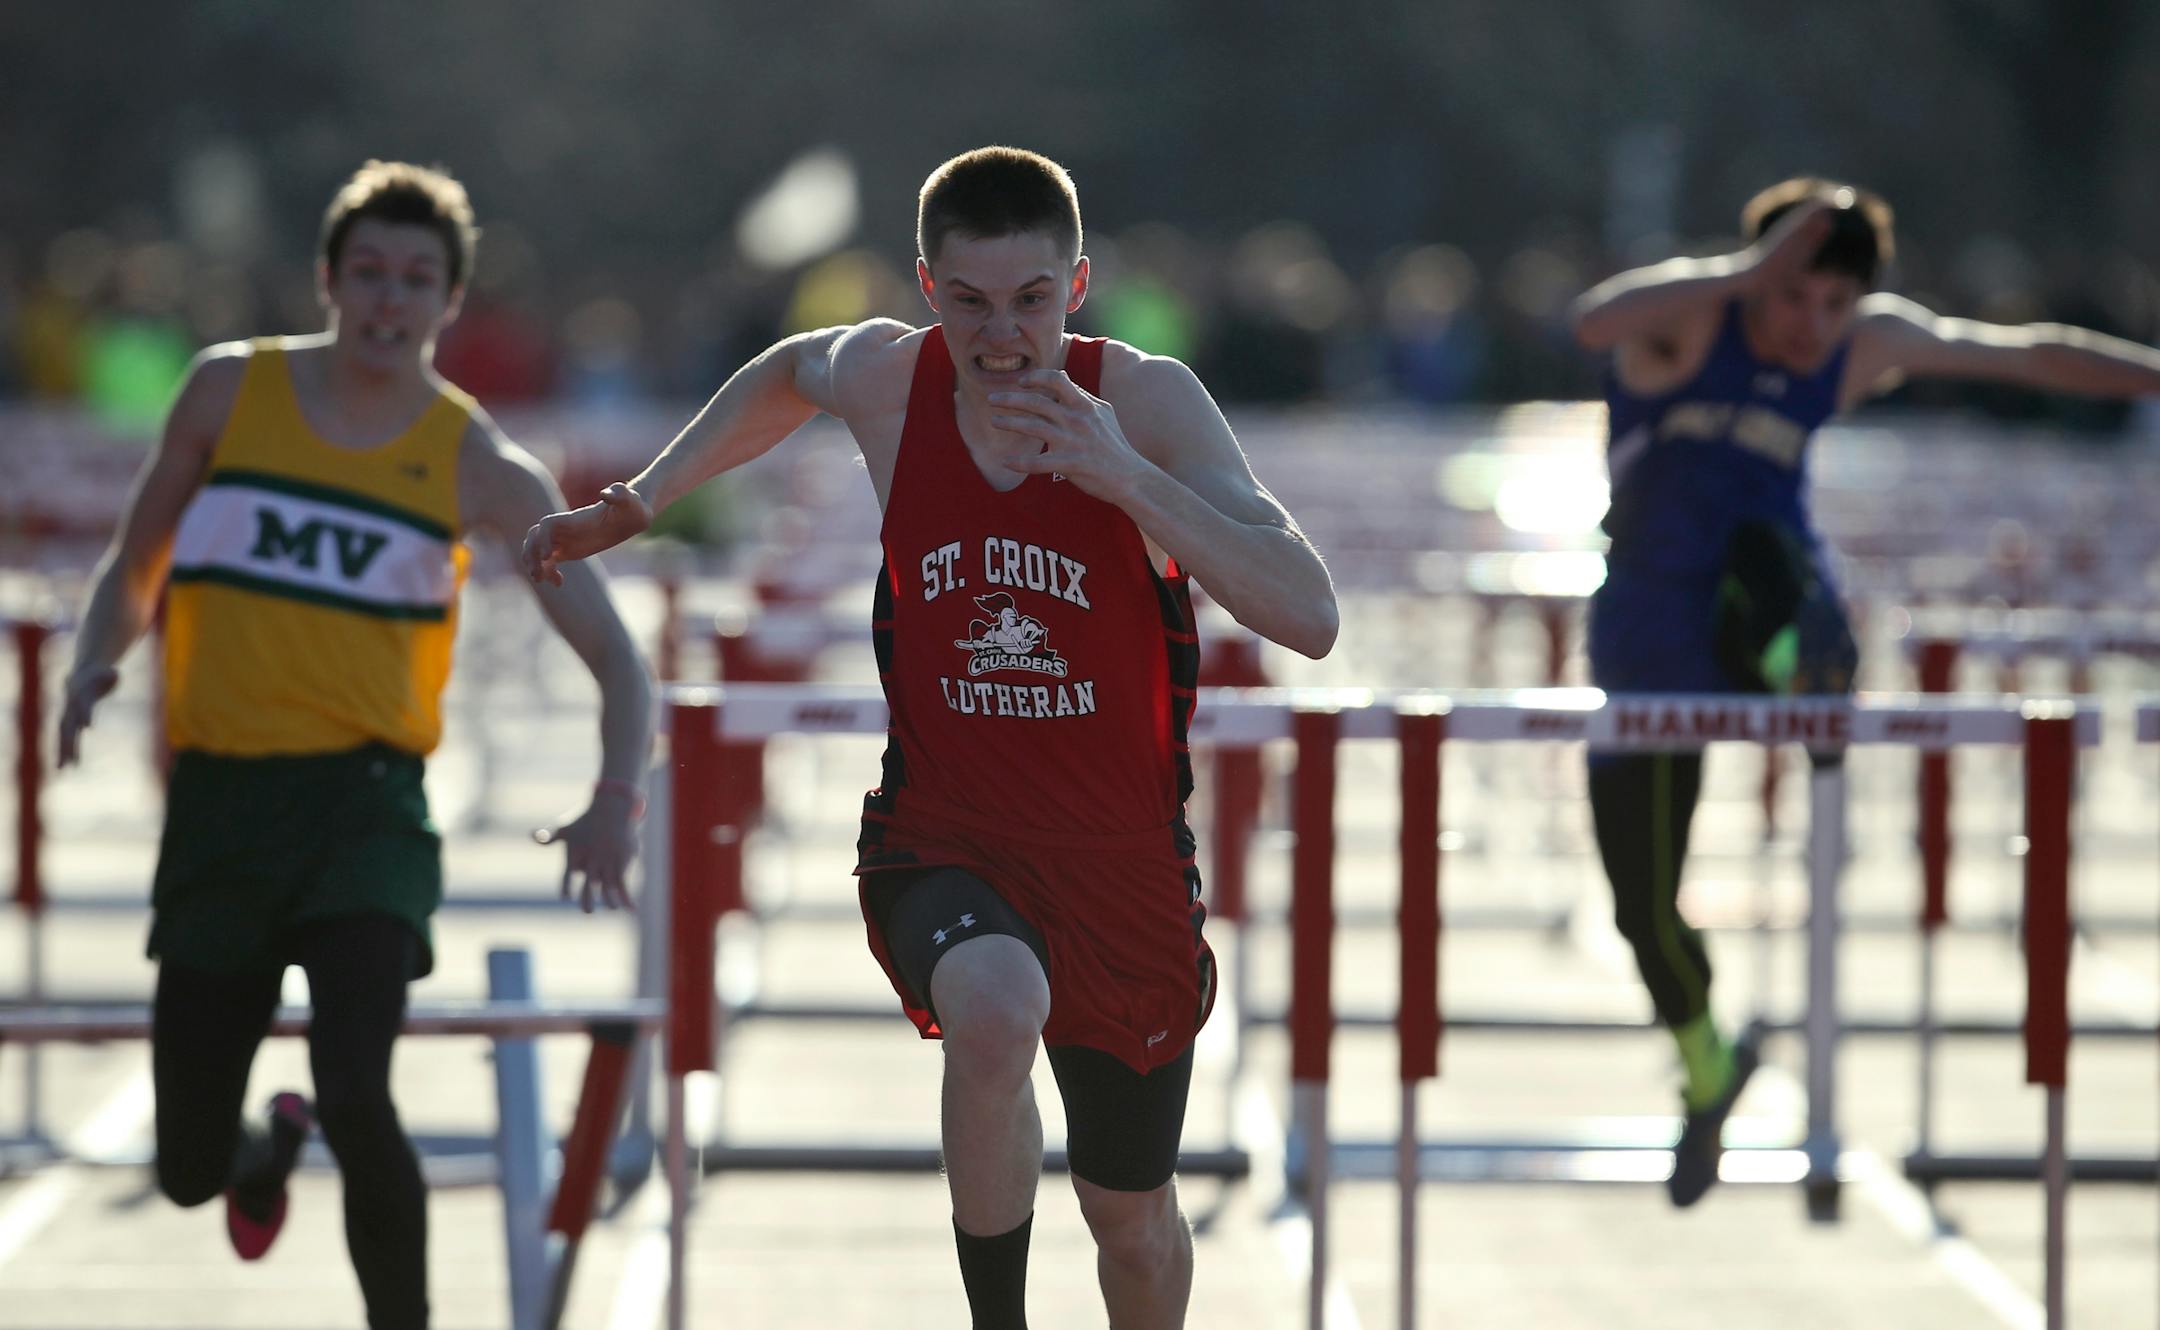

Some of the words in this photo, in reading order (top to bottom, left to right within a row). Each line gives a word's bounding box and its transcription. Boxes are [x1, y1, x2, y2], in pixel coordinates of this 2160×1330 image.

[251, 508, 389, 580] MV
[921, 540, 967, 602] ST.
[984, 536, 1091, 611] CROIX
[970, 653, 1066, 677] CRUSADERS
[939, 677, 1096, 719] LUTHERAN
[1615, 704, 1852, 738] HAMLINE
